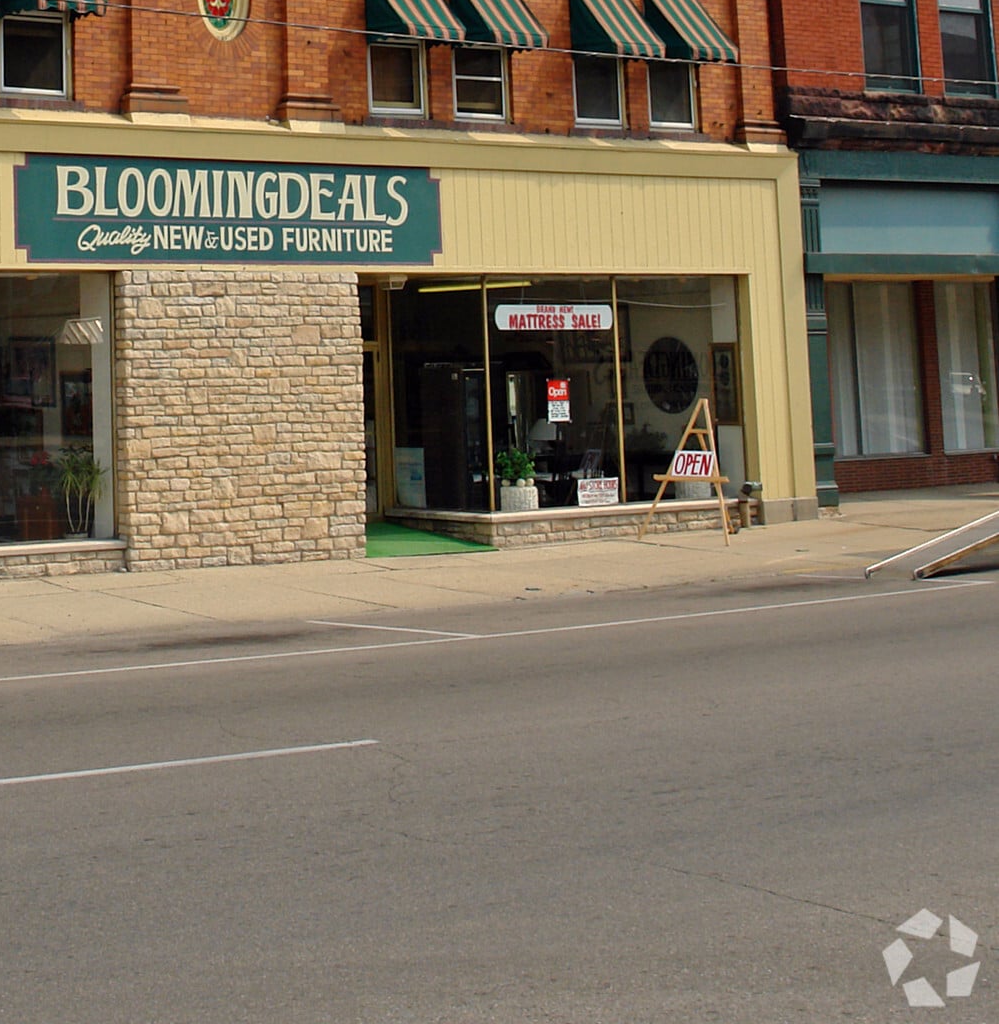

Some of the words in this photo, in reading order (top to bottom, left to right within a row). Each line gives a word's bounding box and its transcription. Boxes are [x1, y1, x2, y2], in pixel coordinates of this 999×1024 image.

[56, 165, 409, 226] BLOOMINGDEALS
[77, 224, 151, 255] Quality
[153, 226, 204, 250] NEW
[219, 226, 274, 251] USED
[282, 227, 393, 252] FURNITURE
[509, 314, 565, 329] MATTRESS
[571, 314, 601, 329] SALE!
[548, 386, 567, 397] Open
[674, 453, 712, 476] OPEN
